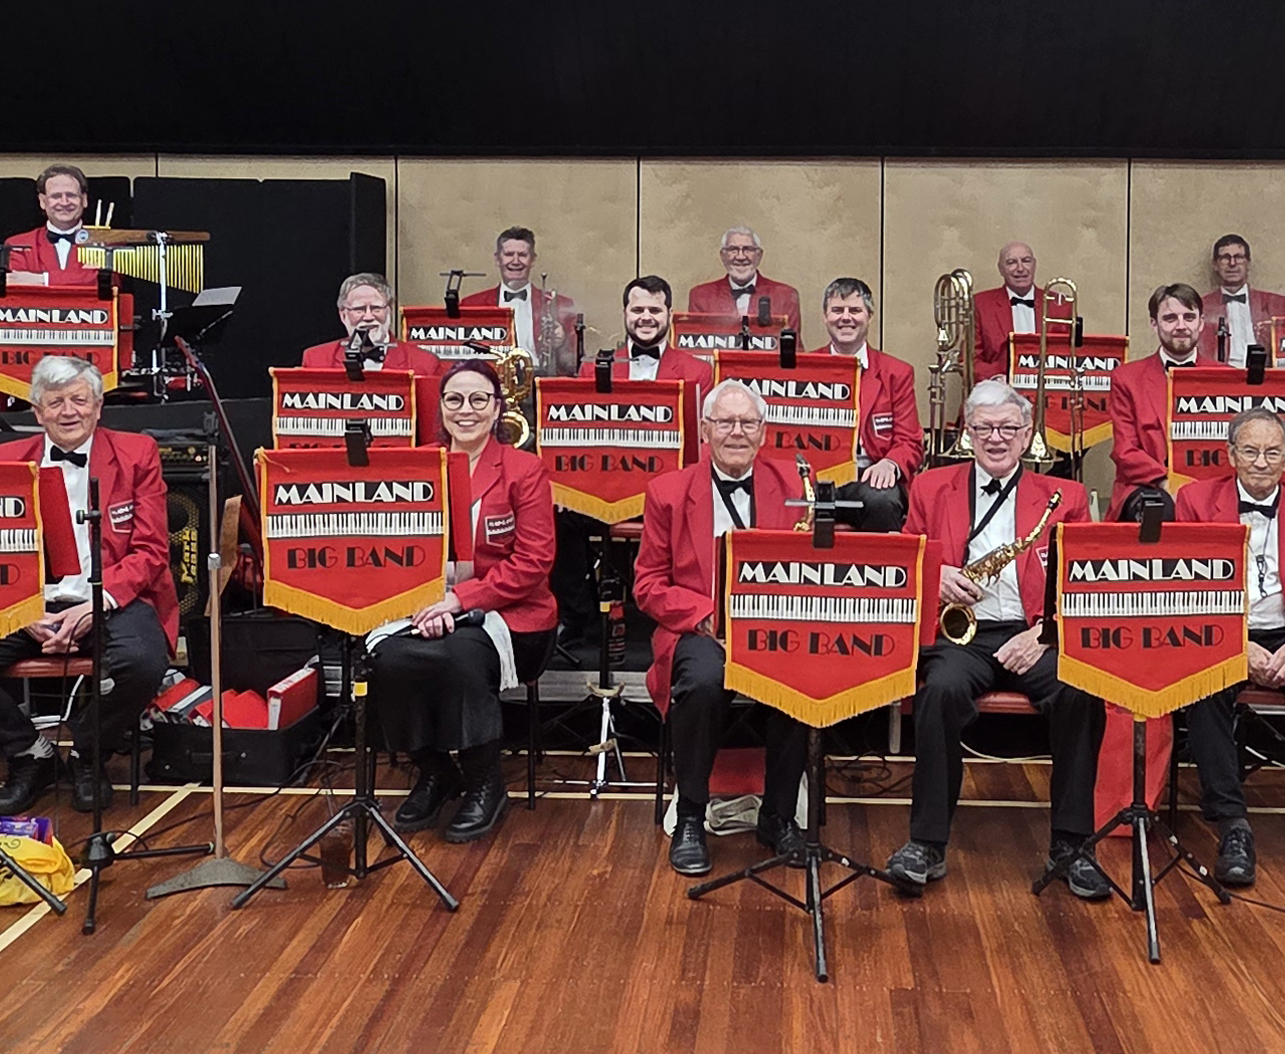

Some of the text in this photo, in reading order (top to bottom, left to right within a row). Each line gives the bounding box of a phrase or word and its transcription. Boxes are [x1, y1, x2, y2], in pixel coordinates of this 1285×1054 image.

[410, 327, 507, 340] MAINLAND
[737, 378, 850, 400] AINLAND
[283, 392, 404, 411] MAINLAND
[547, 404, 673, 423] MAINLAND
[775, 431, 841, 451] BAND
[555, 454, 664, 473] BIG BAND
[1186, 449, 1229, 467] BIG
[275, 481, 434, 505] MAINLAND
[288, 545, 426, 569] BIG BAND
[739, 562, 907, 588] MAINLAND
[1069, 558, 1235, 581] MAINLAND
[748, 628, 895, 657] BIG BAND
[1081, 624, 1225, 649] BIG BAND
